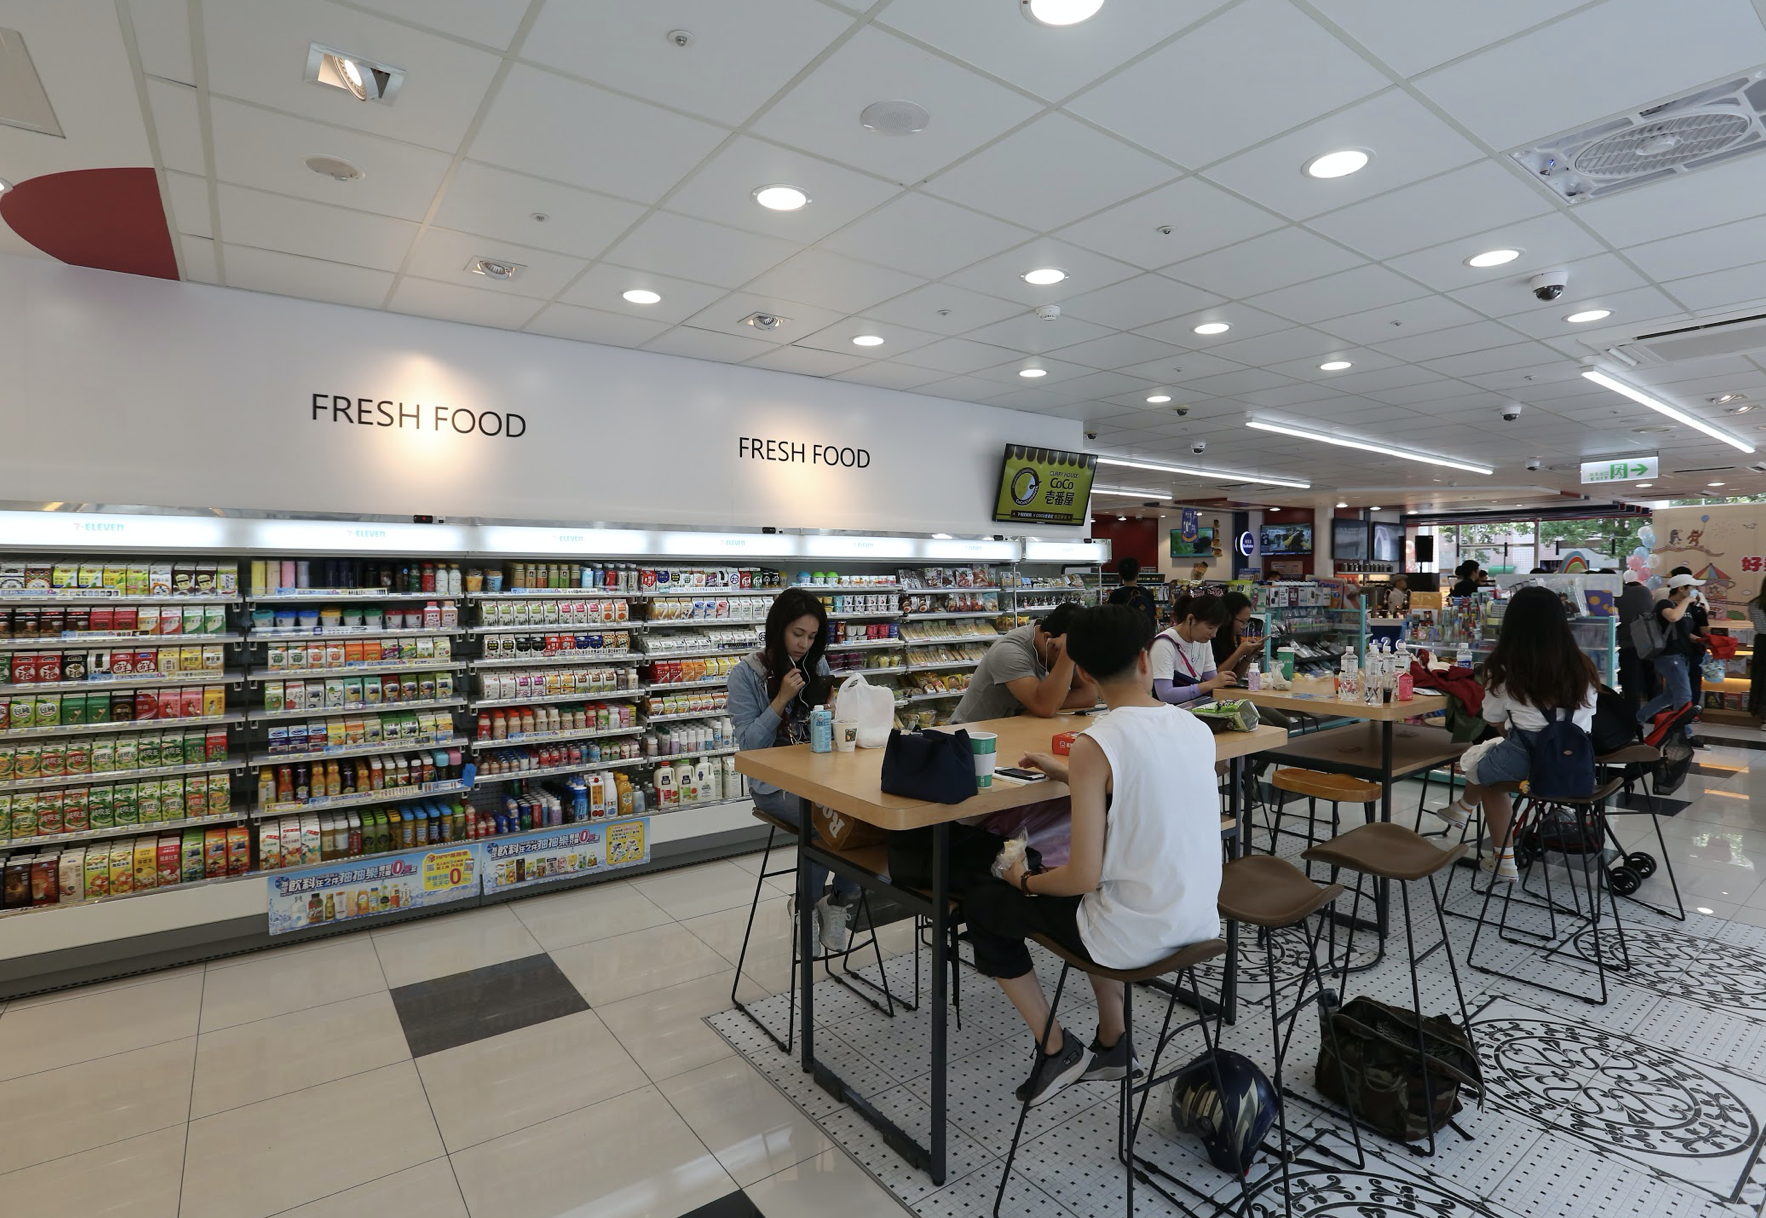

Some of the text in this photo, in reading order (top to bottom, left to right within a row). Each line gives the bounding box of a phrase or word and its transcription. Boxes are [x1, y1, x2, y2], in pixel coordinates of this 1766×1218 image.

[312, 393, 527, 438] FRESH FOOD
[739, 437, 871, 469] FRESH FOOD
[1050, 470, 1064, 478] CURRY
[1050, 477, 1074, 490] CoCo
[73, 523, 125, 532] 7-ELEVEN
[347, 530, 386, 538] 7-ELEVEN
[1741, 556, 1766, 573] 好
